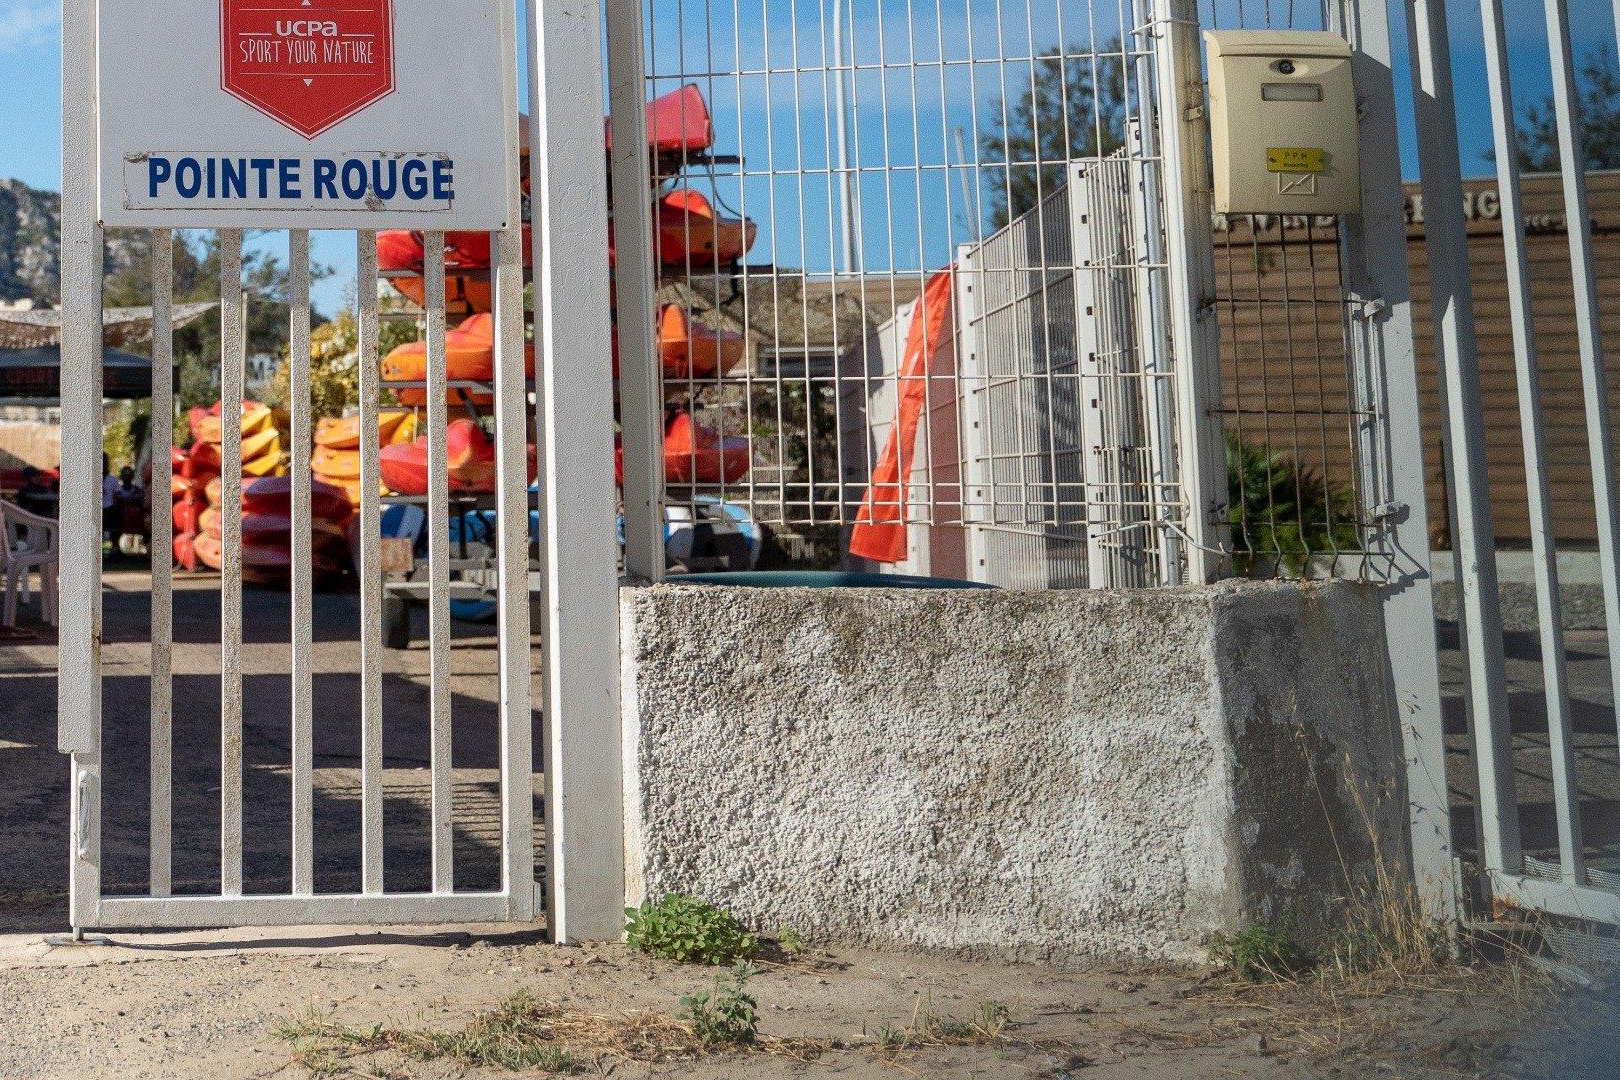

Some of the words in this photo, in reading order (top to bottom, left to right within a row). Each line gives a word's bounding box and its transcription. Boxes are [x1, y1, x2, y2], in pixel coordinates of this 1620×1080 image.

[239, 39, 282, 63] SPORT
[286, 39, 317, 64] YOUR
[323, 40, 374, 64] NATURE
[148, 157, 302, 199] POINTE
[313, 158, 455, 200] ROUGE
